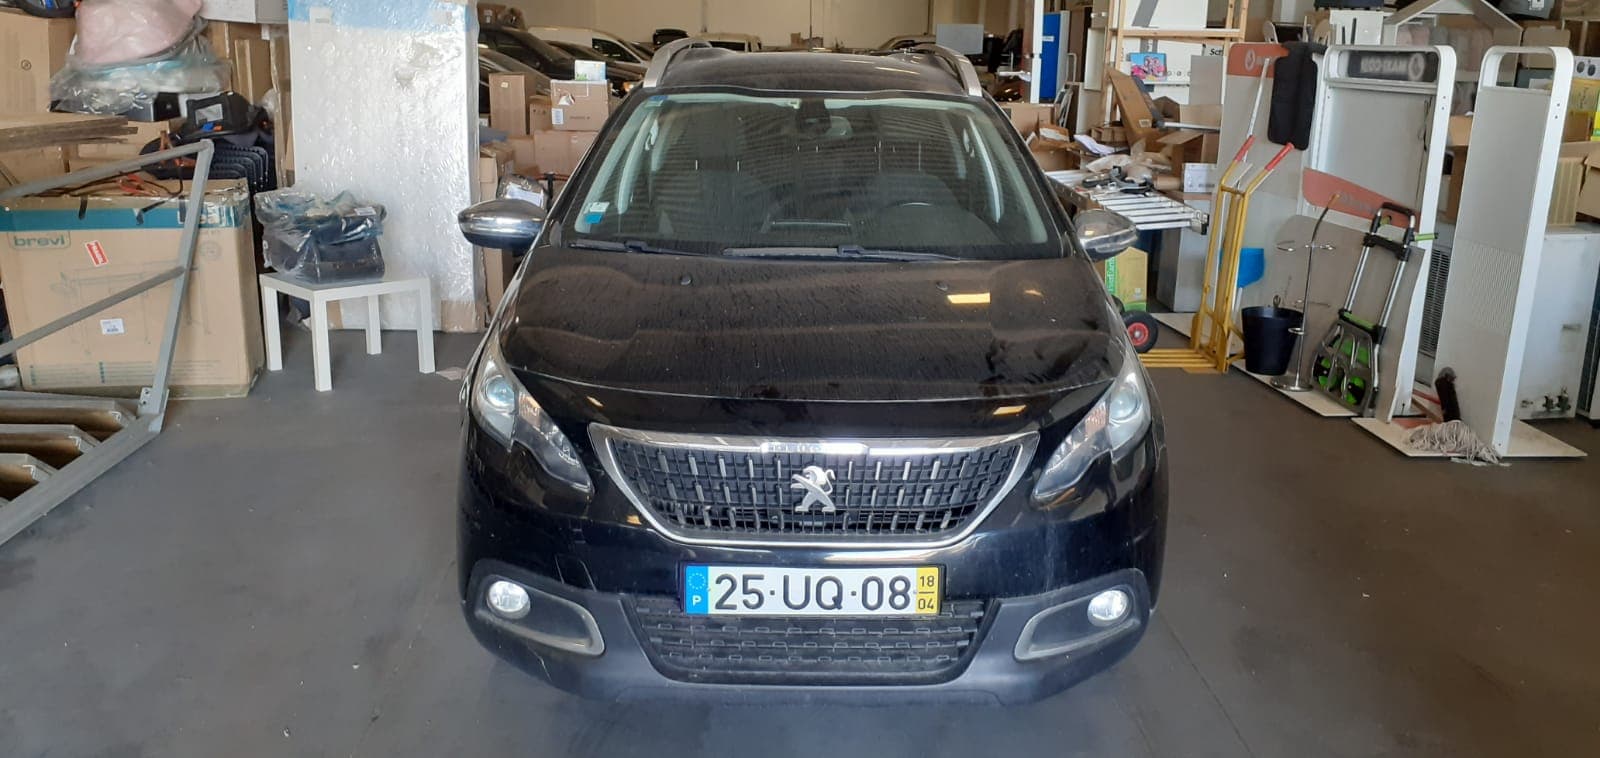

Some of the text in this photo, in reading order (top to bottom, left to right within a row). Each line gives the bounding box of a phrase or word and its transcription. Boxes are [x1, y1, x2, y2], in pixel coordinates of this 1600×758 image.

[13, 235, 65, 246] brevi
[919, 575, 935, 587] 18
[692, 595, 702, 607] P
[918, 598, 934, 610] 04
